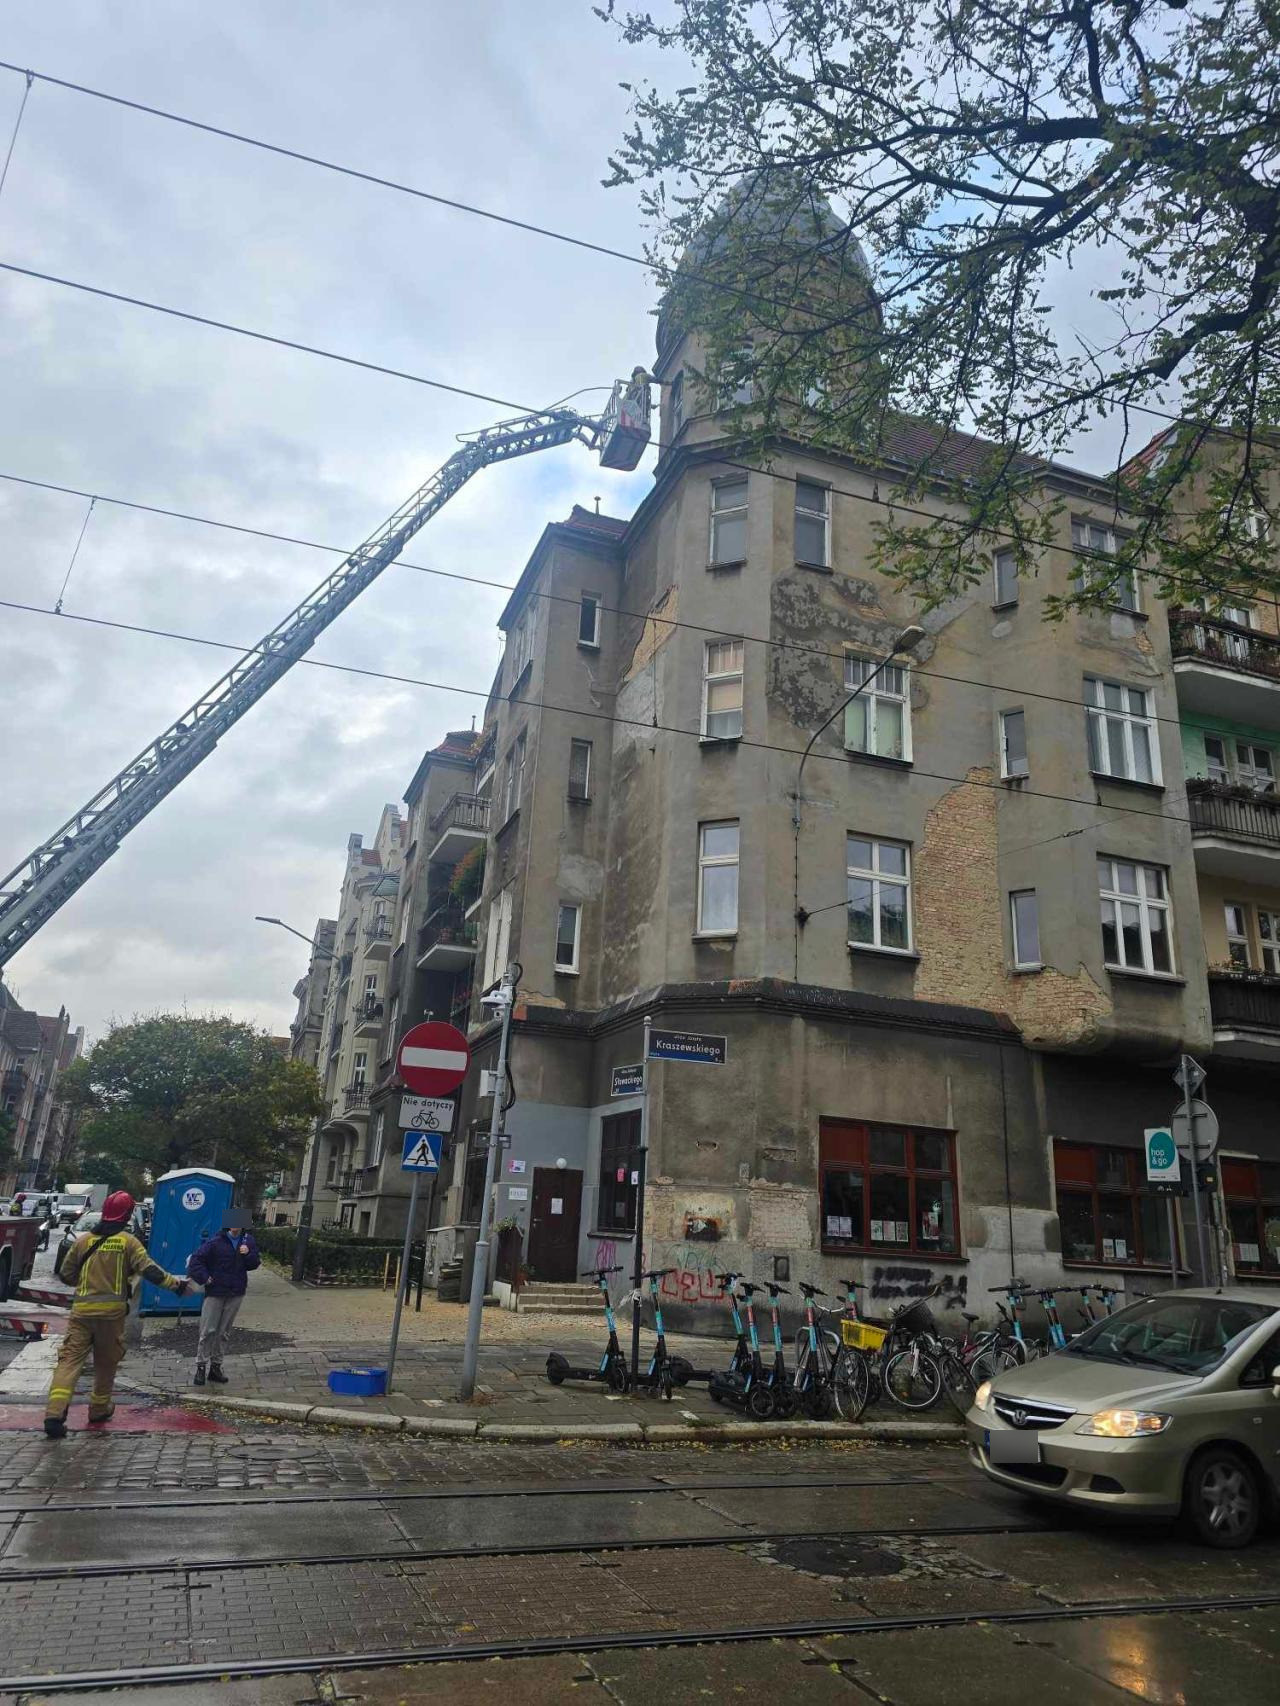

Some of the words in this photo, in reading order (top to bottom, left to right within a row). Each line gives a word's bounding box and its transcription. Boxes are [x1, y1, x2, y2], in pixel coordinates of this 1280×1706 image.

[656, 1040, 721, 1055] Kraszewskiego
[404, 1097, 418, 1106] Nie
[421, 1099, 453, 1111] dotyczy
[1151, 1148, 1165, 1158] hop
